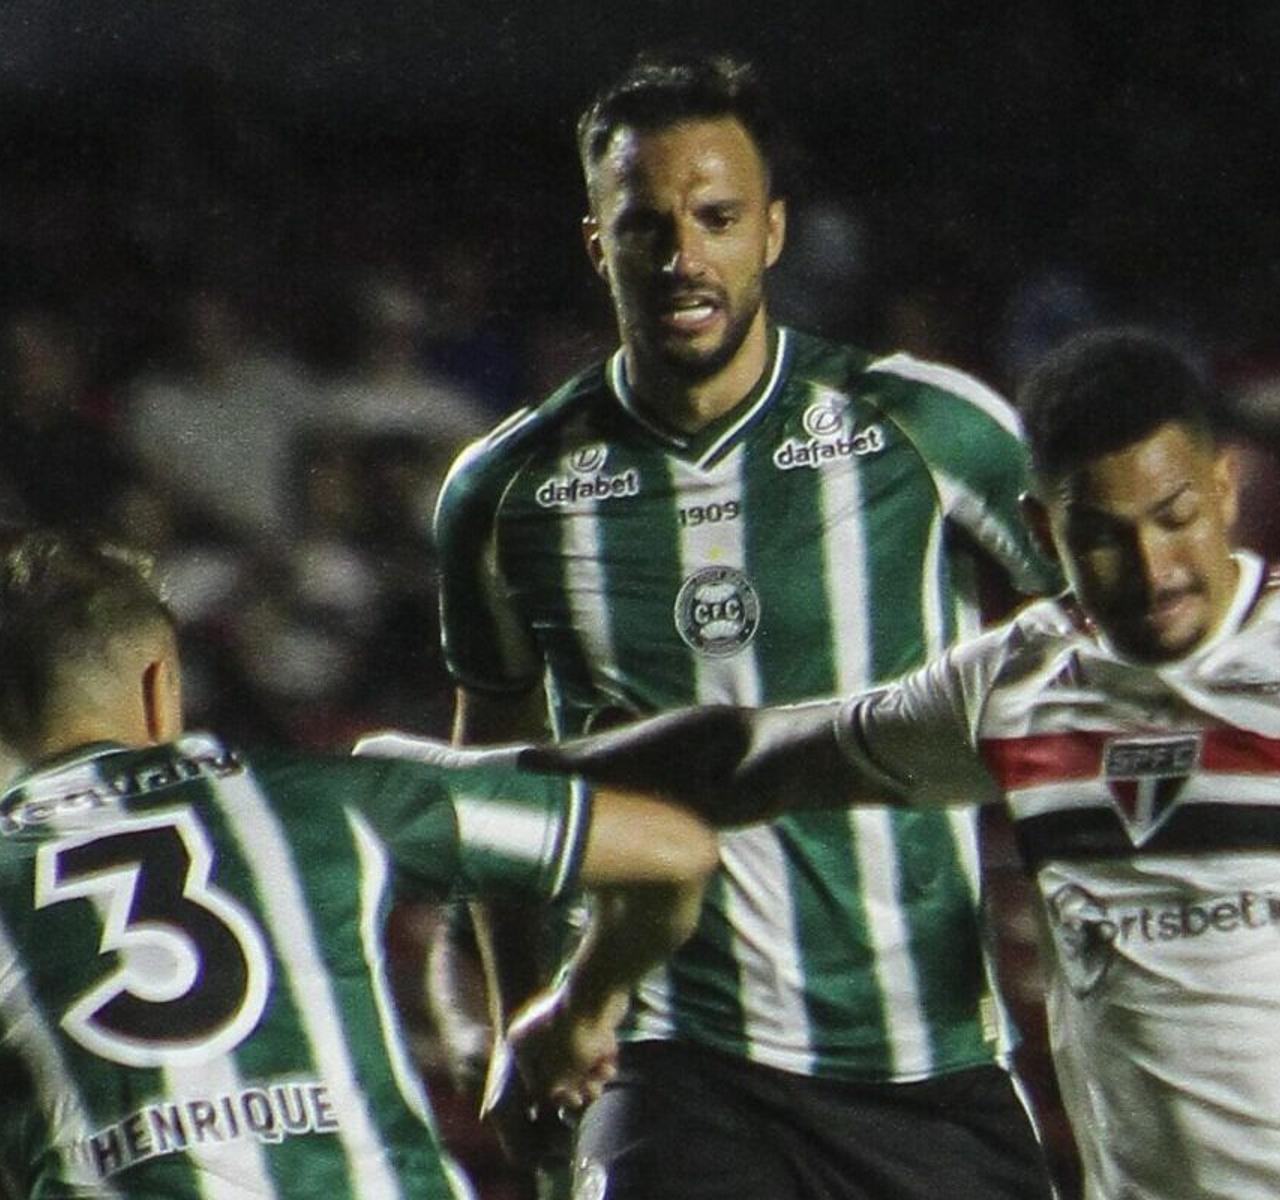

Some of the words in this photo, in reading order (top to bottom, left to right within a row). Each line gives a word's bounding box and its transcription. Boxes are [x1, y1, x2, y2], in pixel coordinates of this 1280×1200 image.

[774, 428, 884, 470] dafabet
[536, 470, 639, 507] dafabet
[677, 500, 741, 528] 1909
[36, 800, 272, 1068] 3
[87, 1083, 342, 1178] HENRIQUE
